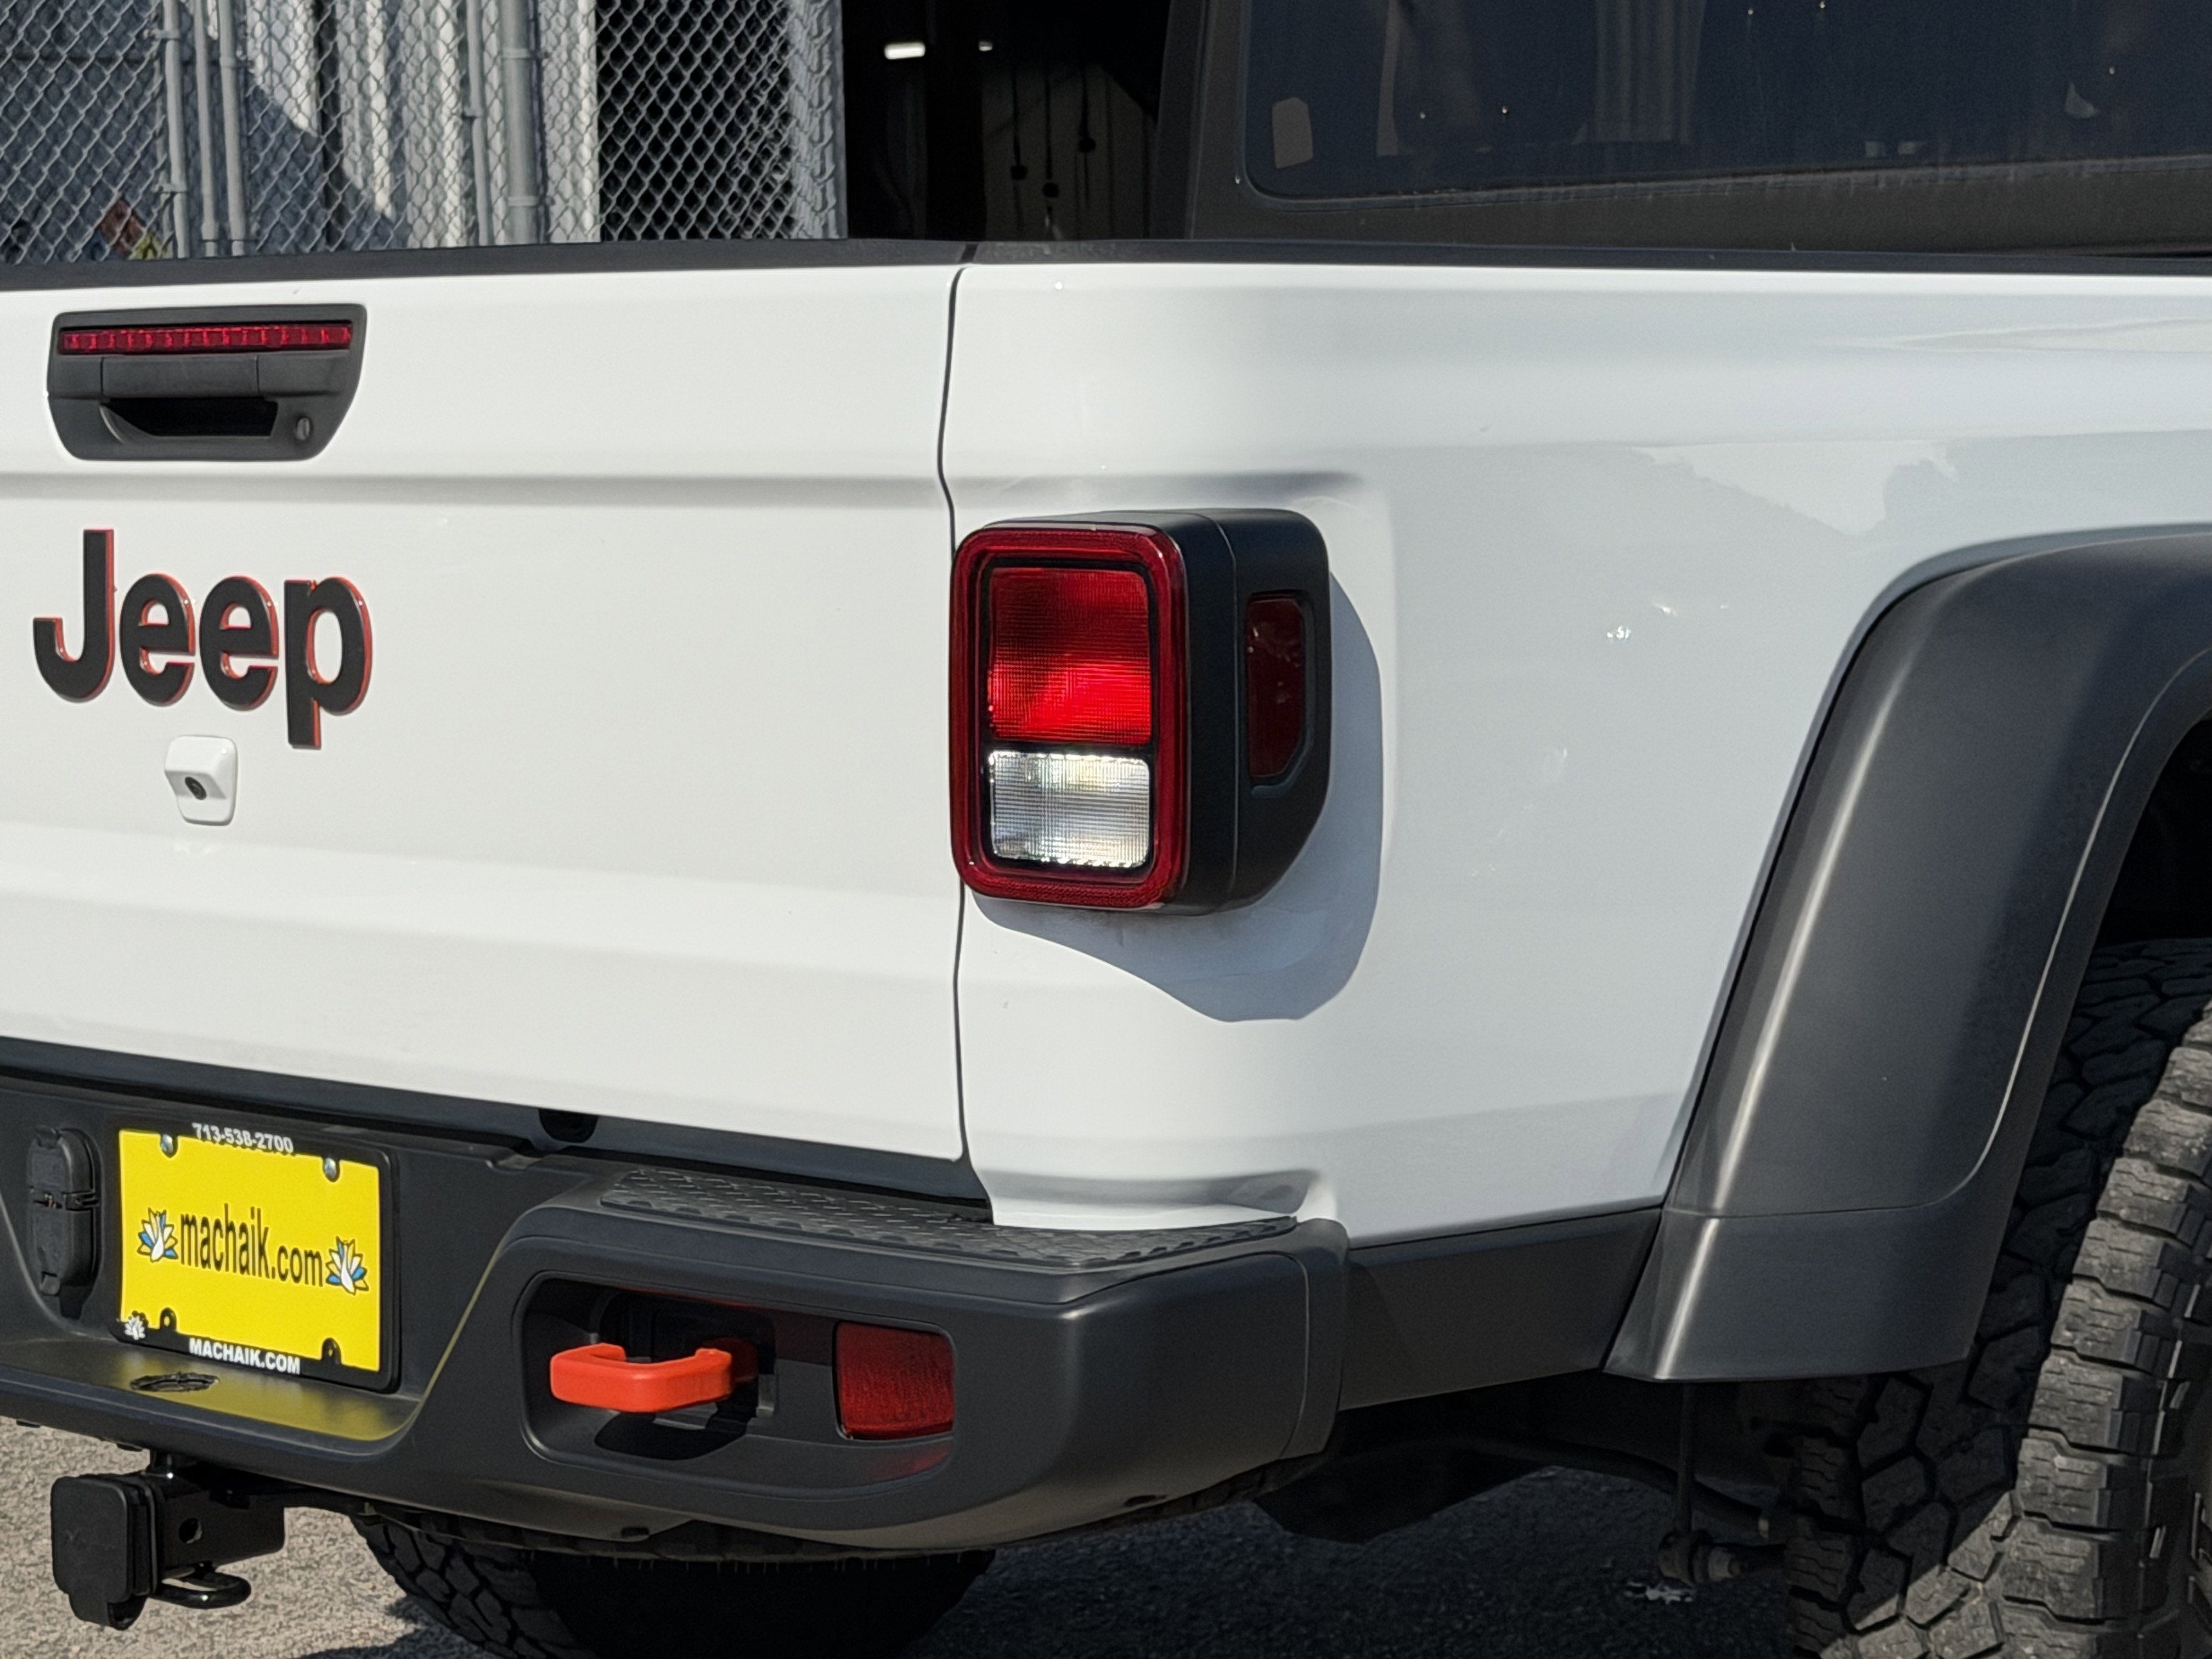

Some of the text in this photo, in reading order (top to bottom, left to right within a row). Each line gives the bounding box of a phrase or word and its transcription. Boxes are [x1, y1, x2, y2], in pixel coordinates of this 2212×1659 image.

[33, 528, 373, 750] Jeep
[191, 1122, 294, 1154] 713-538-2700
[180, 1203, 323, 1287] machaik.com
[189, 1338, 301, 1374] MACHAIK.COM
